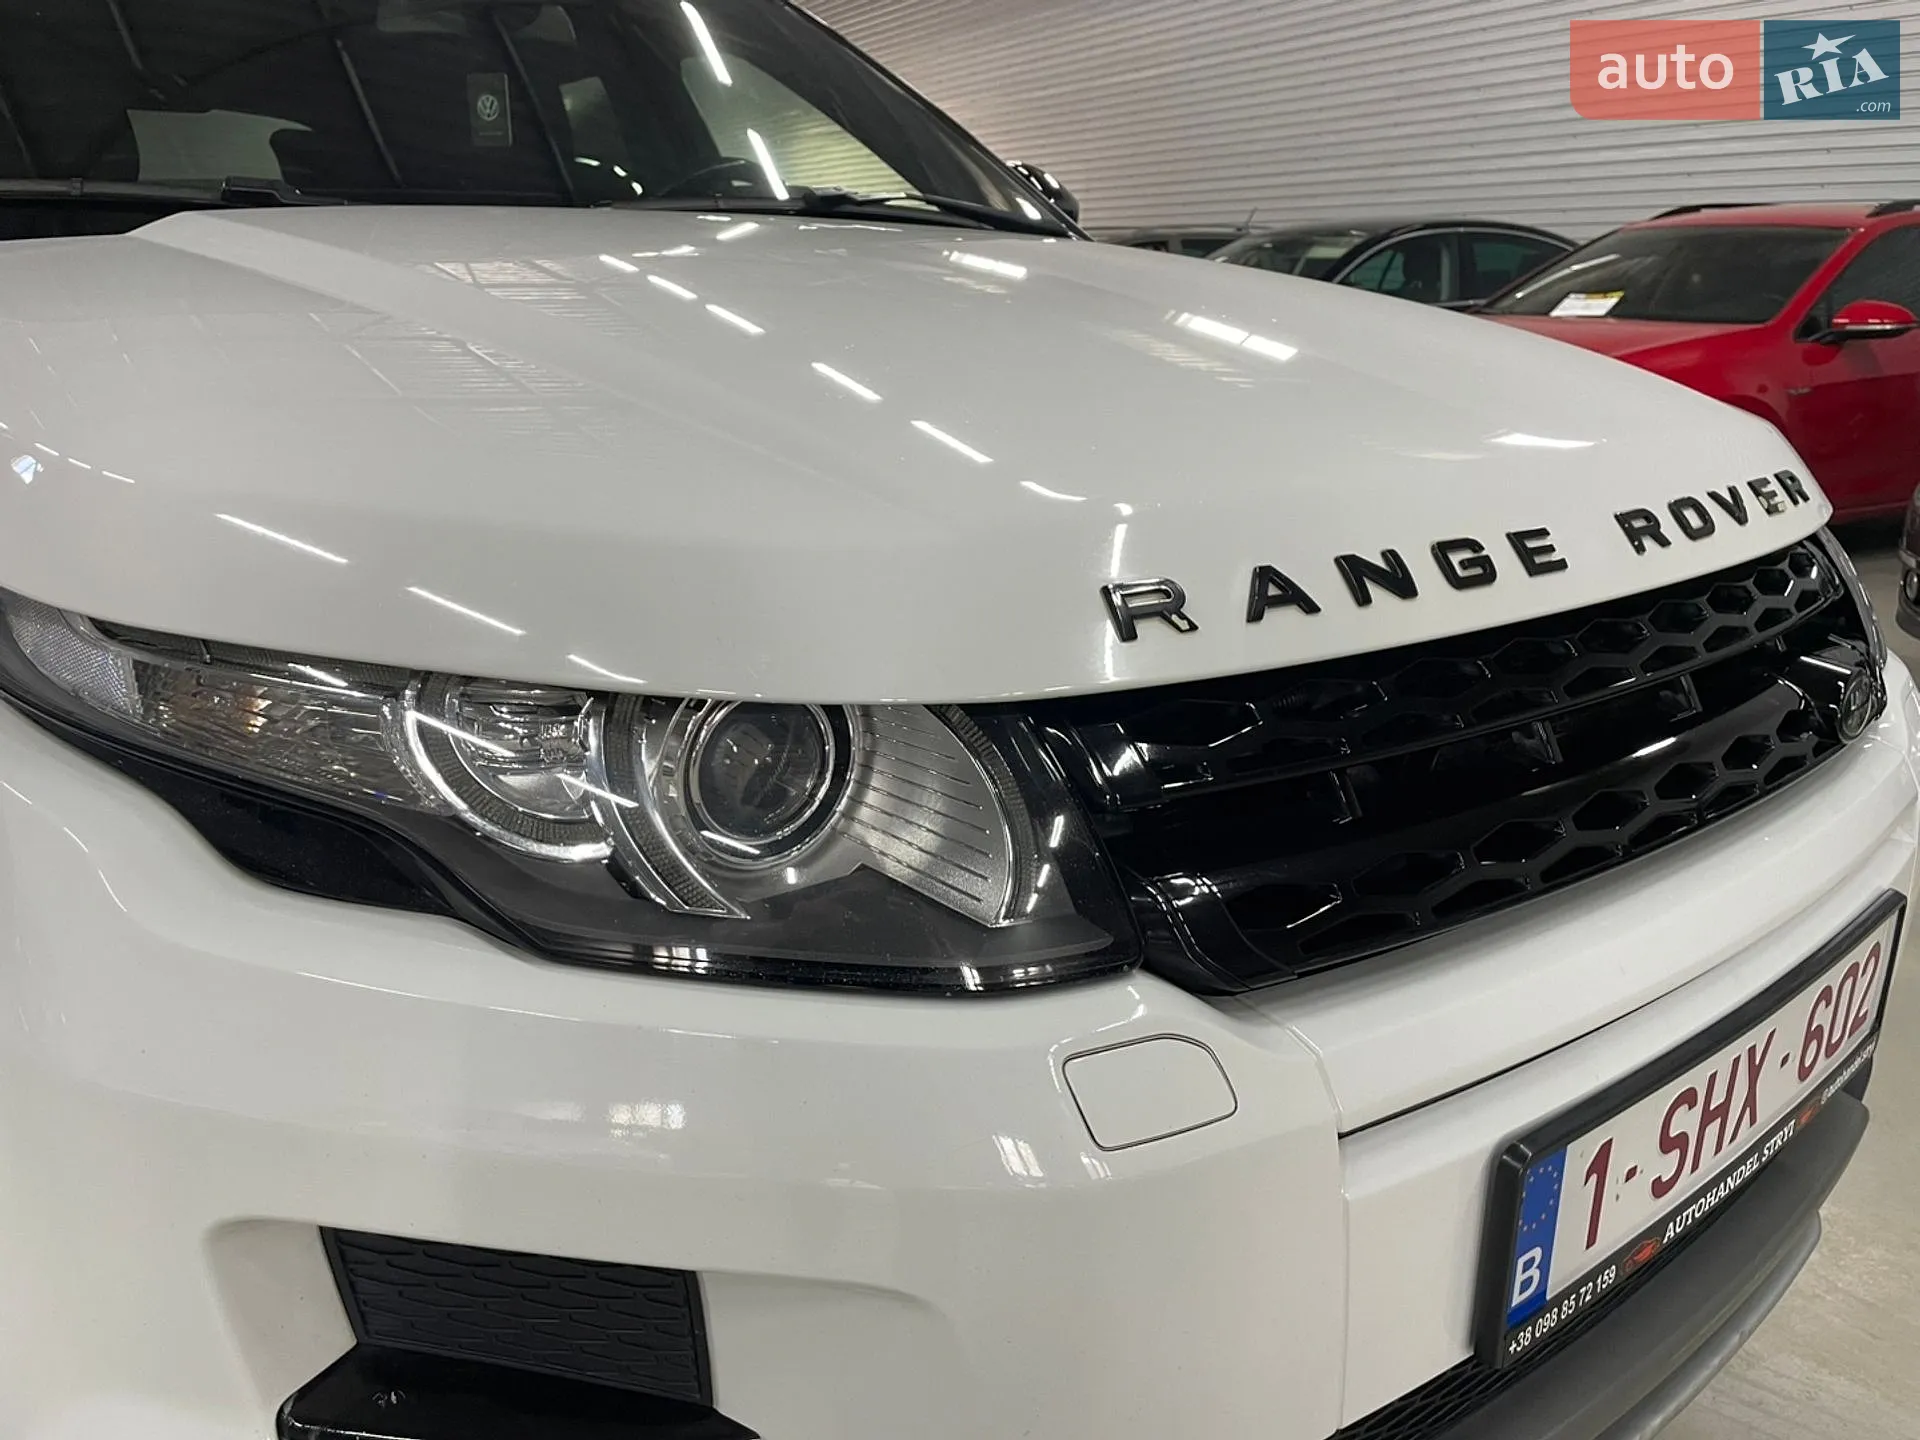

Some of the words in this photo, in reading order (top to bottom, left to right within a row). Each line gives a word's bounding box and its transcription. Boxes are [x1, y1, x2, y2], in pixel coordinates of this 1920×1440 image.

[1100, 526, 1569, 643] RANGE
[1613, 469, 1810, 556] ROVER
[1583, 940, 1881, 1251] 1-SHX-602
[1662, 1152, 1760, 1244] AUTOHANDEL
[1508, 1326, 1532, 1354] +38
[1535, 1307, 1558, 1338] 098
[1561, 1293, 1576, 1319] 85
[1579, 1281, 1593, 1307] 72
[1596, 1264, 1616, 1293] 159
[1511, 1246, 1543, 1308] B
